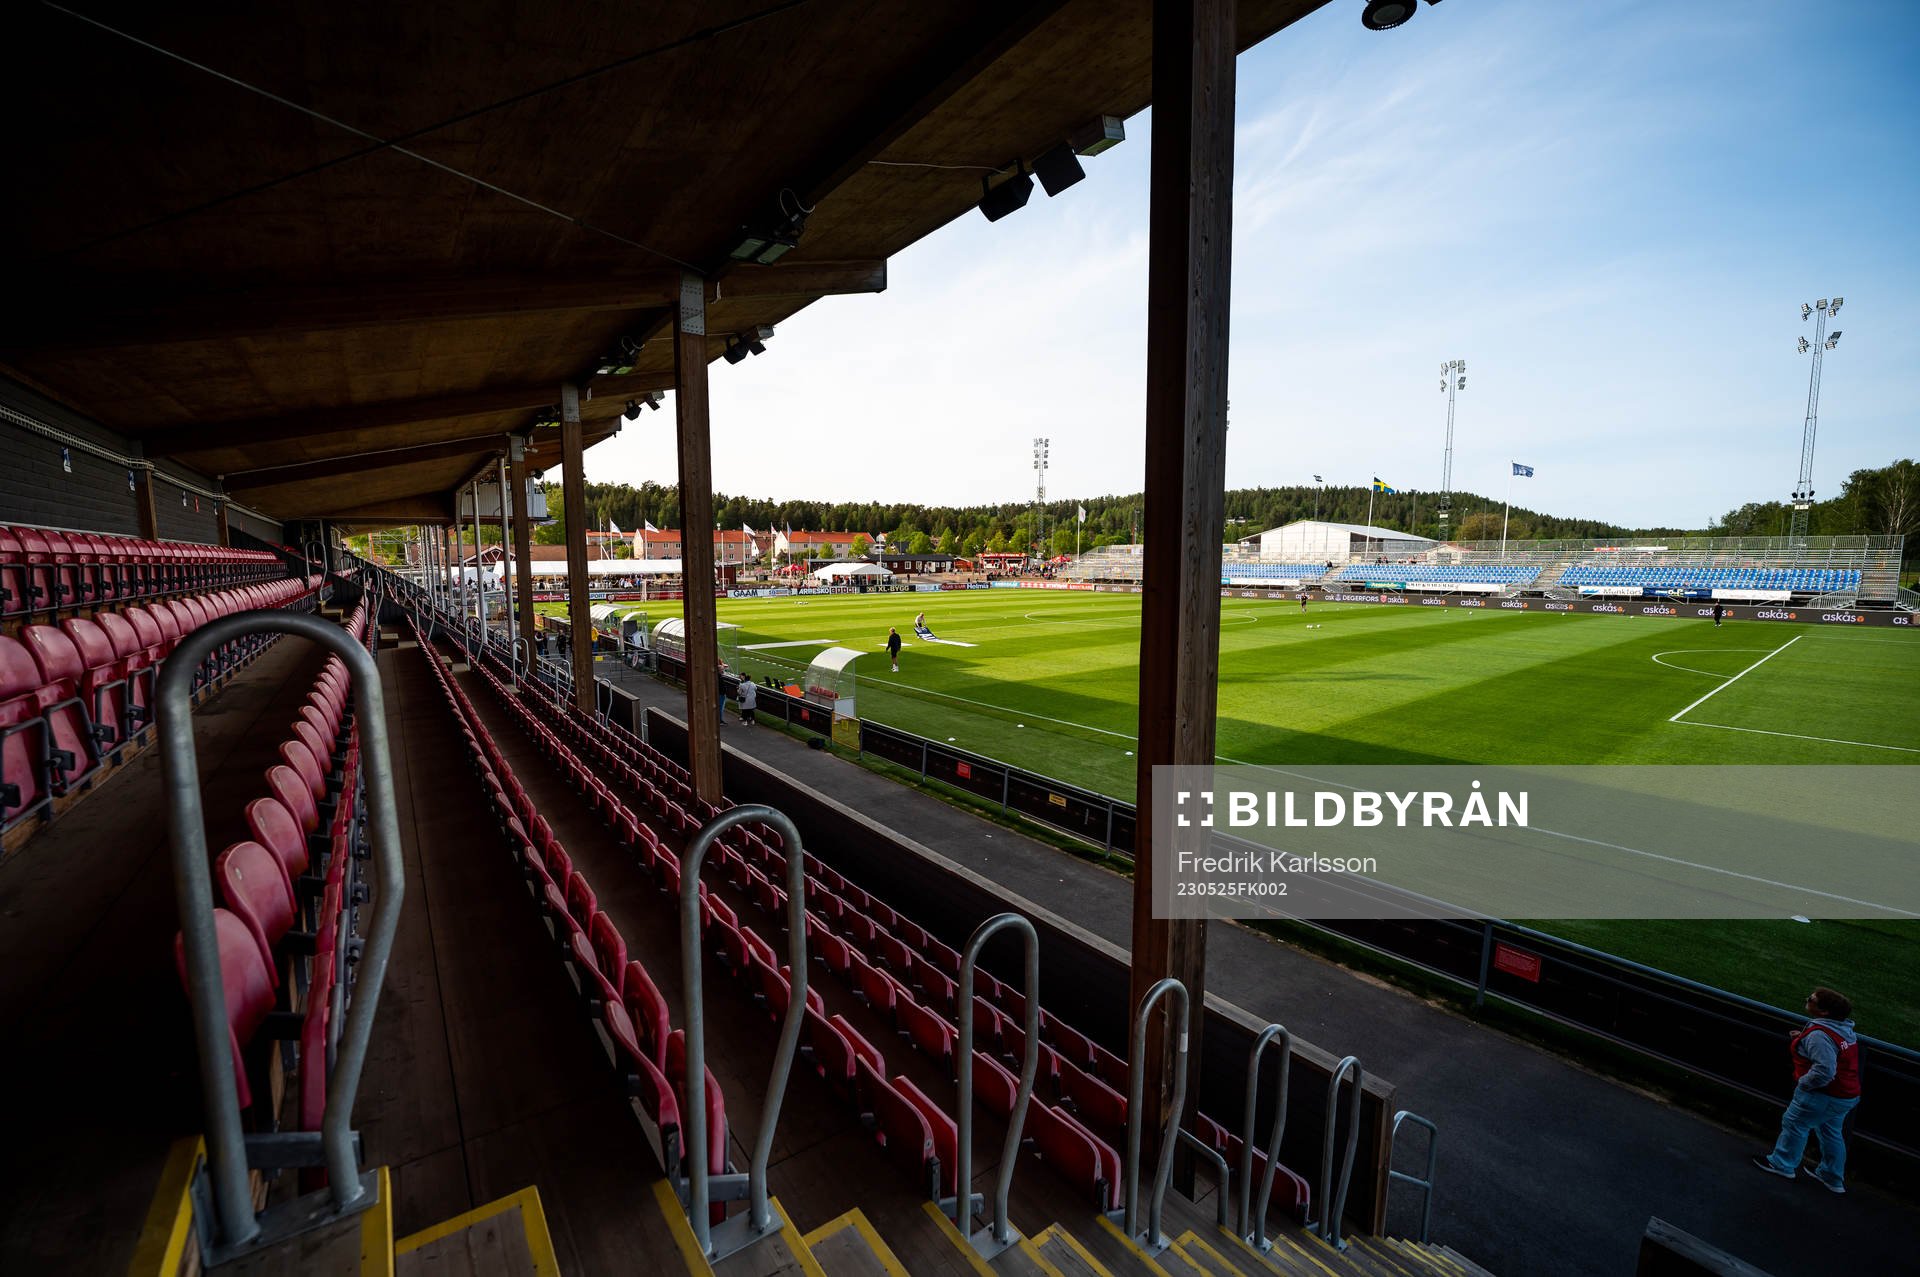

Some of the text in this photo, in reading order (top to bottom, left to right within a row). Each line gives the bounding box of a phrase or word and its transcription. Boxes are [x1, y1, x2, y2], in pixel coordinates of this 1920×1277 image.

[1342, 594, 1380, 602] DEGERFORS
[1422, 597, 1442, 605] askås
[1460, 598, 1481, 607] askås
[1501, 600, 1523, 609] askås
[1592, 602, 1617, 613] askås
[1642, 604, 1670, 615] askås
[1697, 606, 1727, 617] asks
[1757, 608, 1789, 620] askås
[1822, 611, 1857, 623] askås
